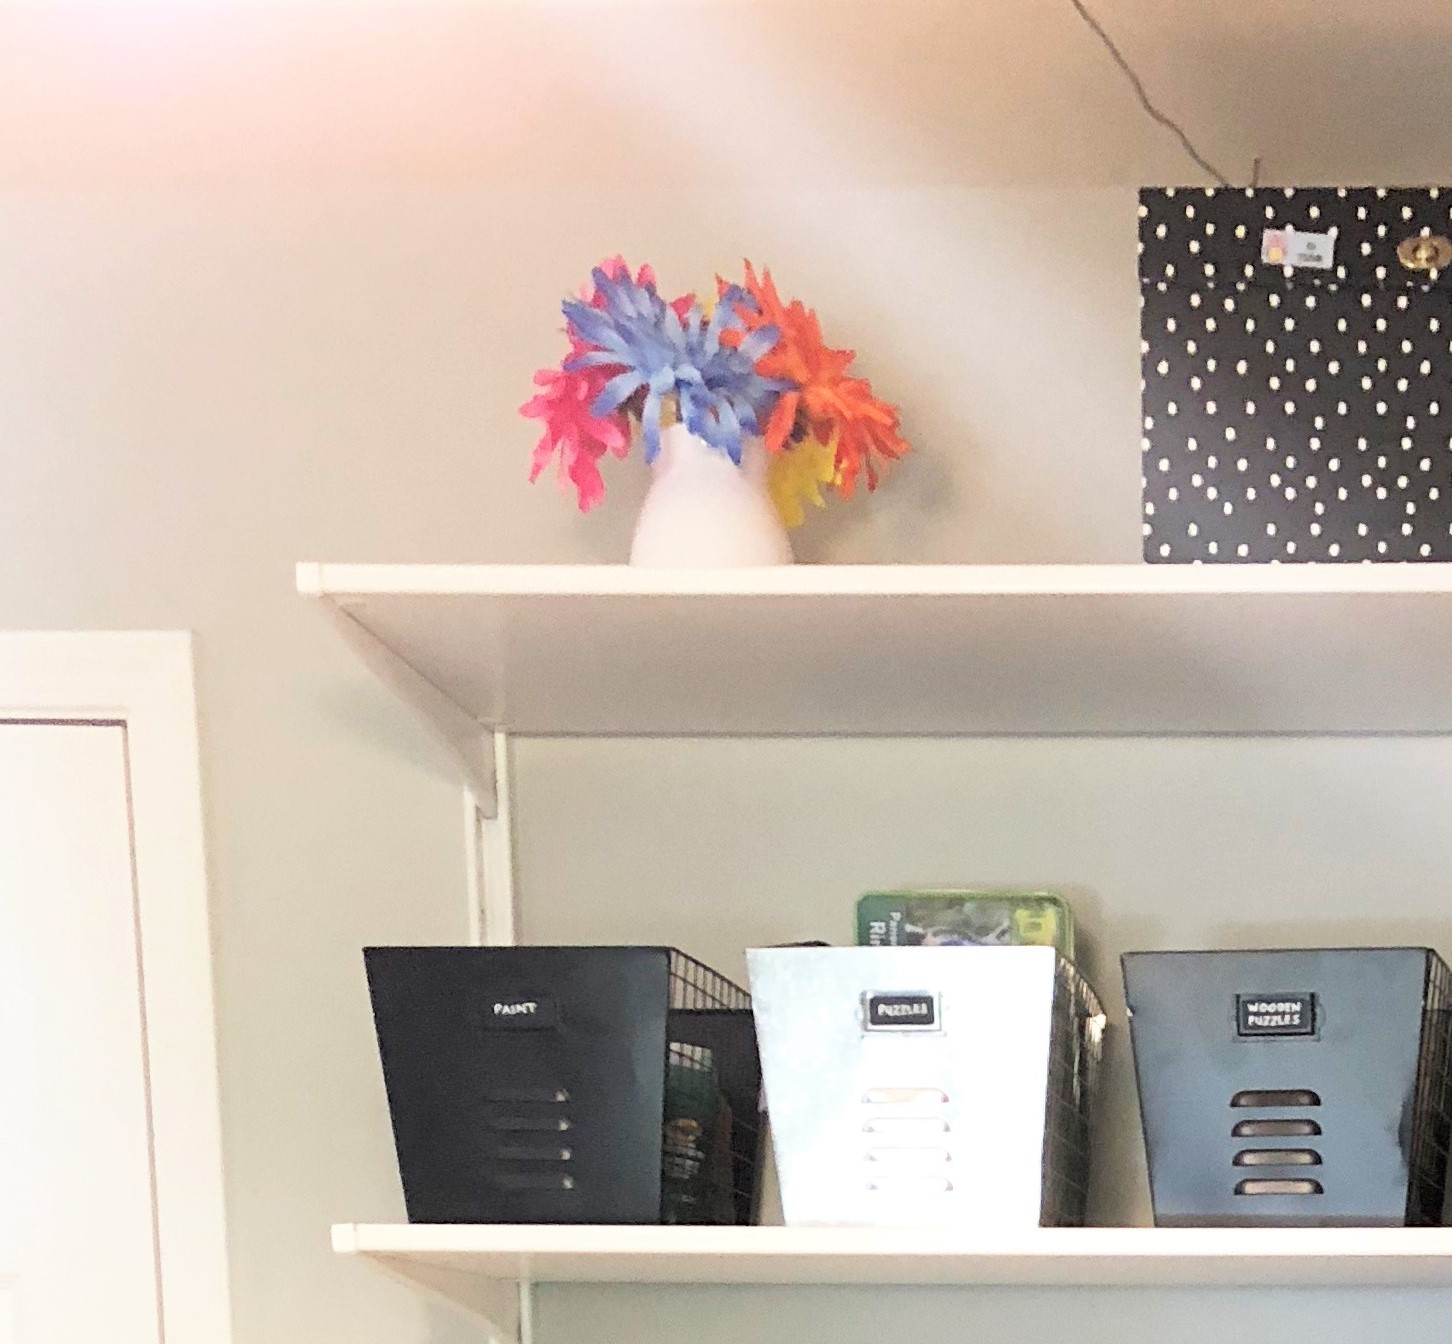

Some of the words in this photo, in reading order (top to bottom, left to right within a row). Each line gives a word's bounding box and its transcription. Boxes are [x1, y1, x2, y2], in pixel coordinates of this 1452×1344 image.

[493, 1002, 538, 1015] PAINT
[1247, 1002, 1302, 1013] WOODEN
[1248, 1014, 1301, 1027] PUZZLES
